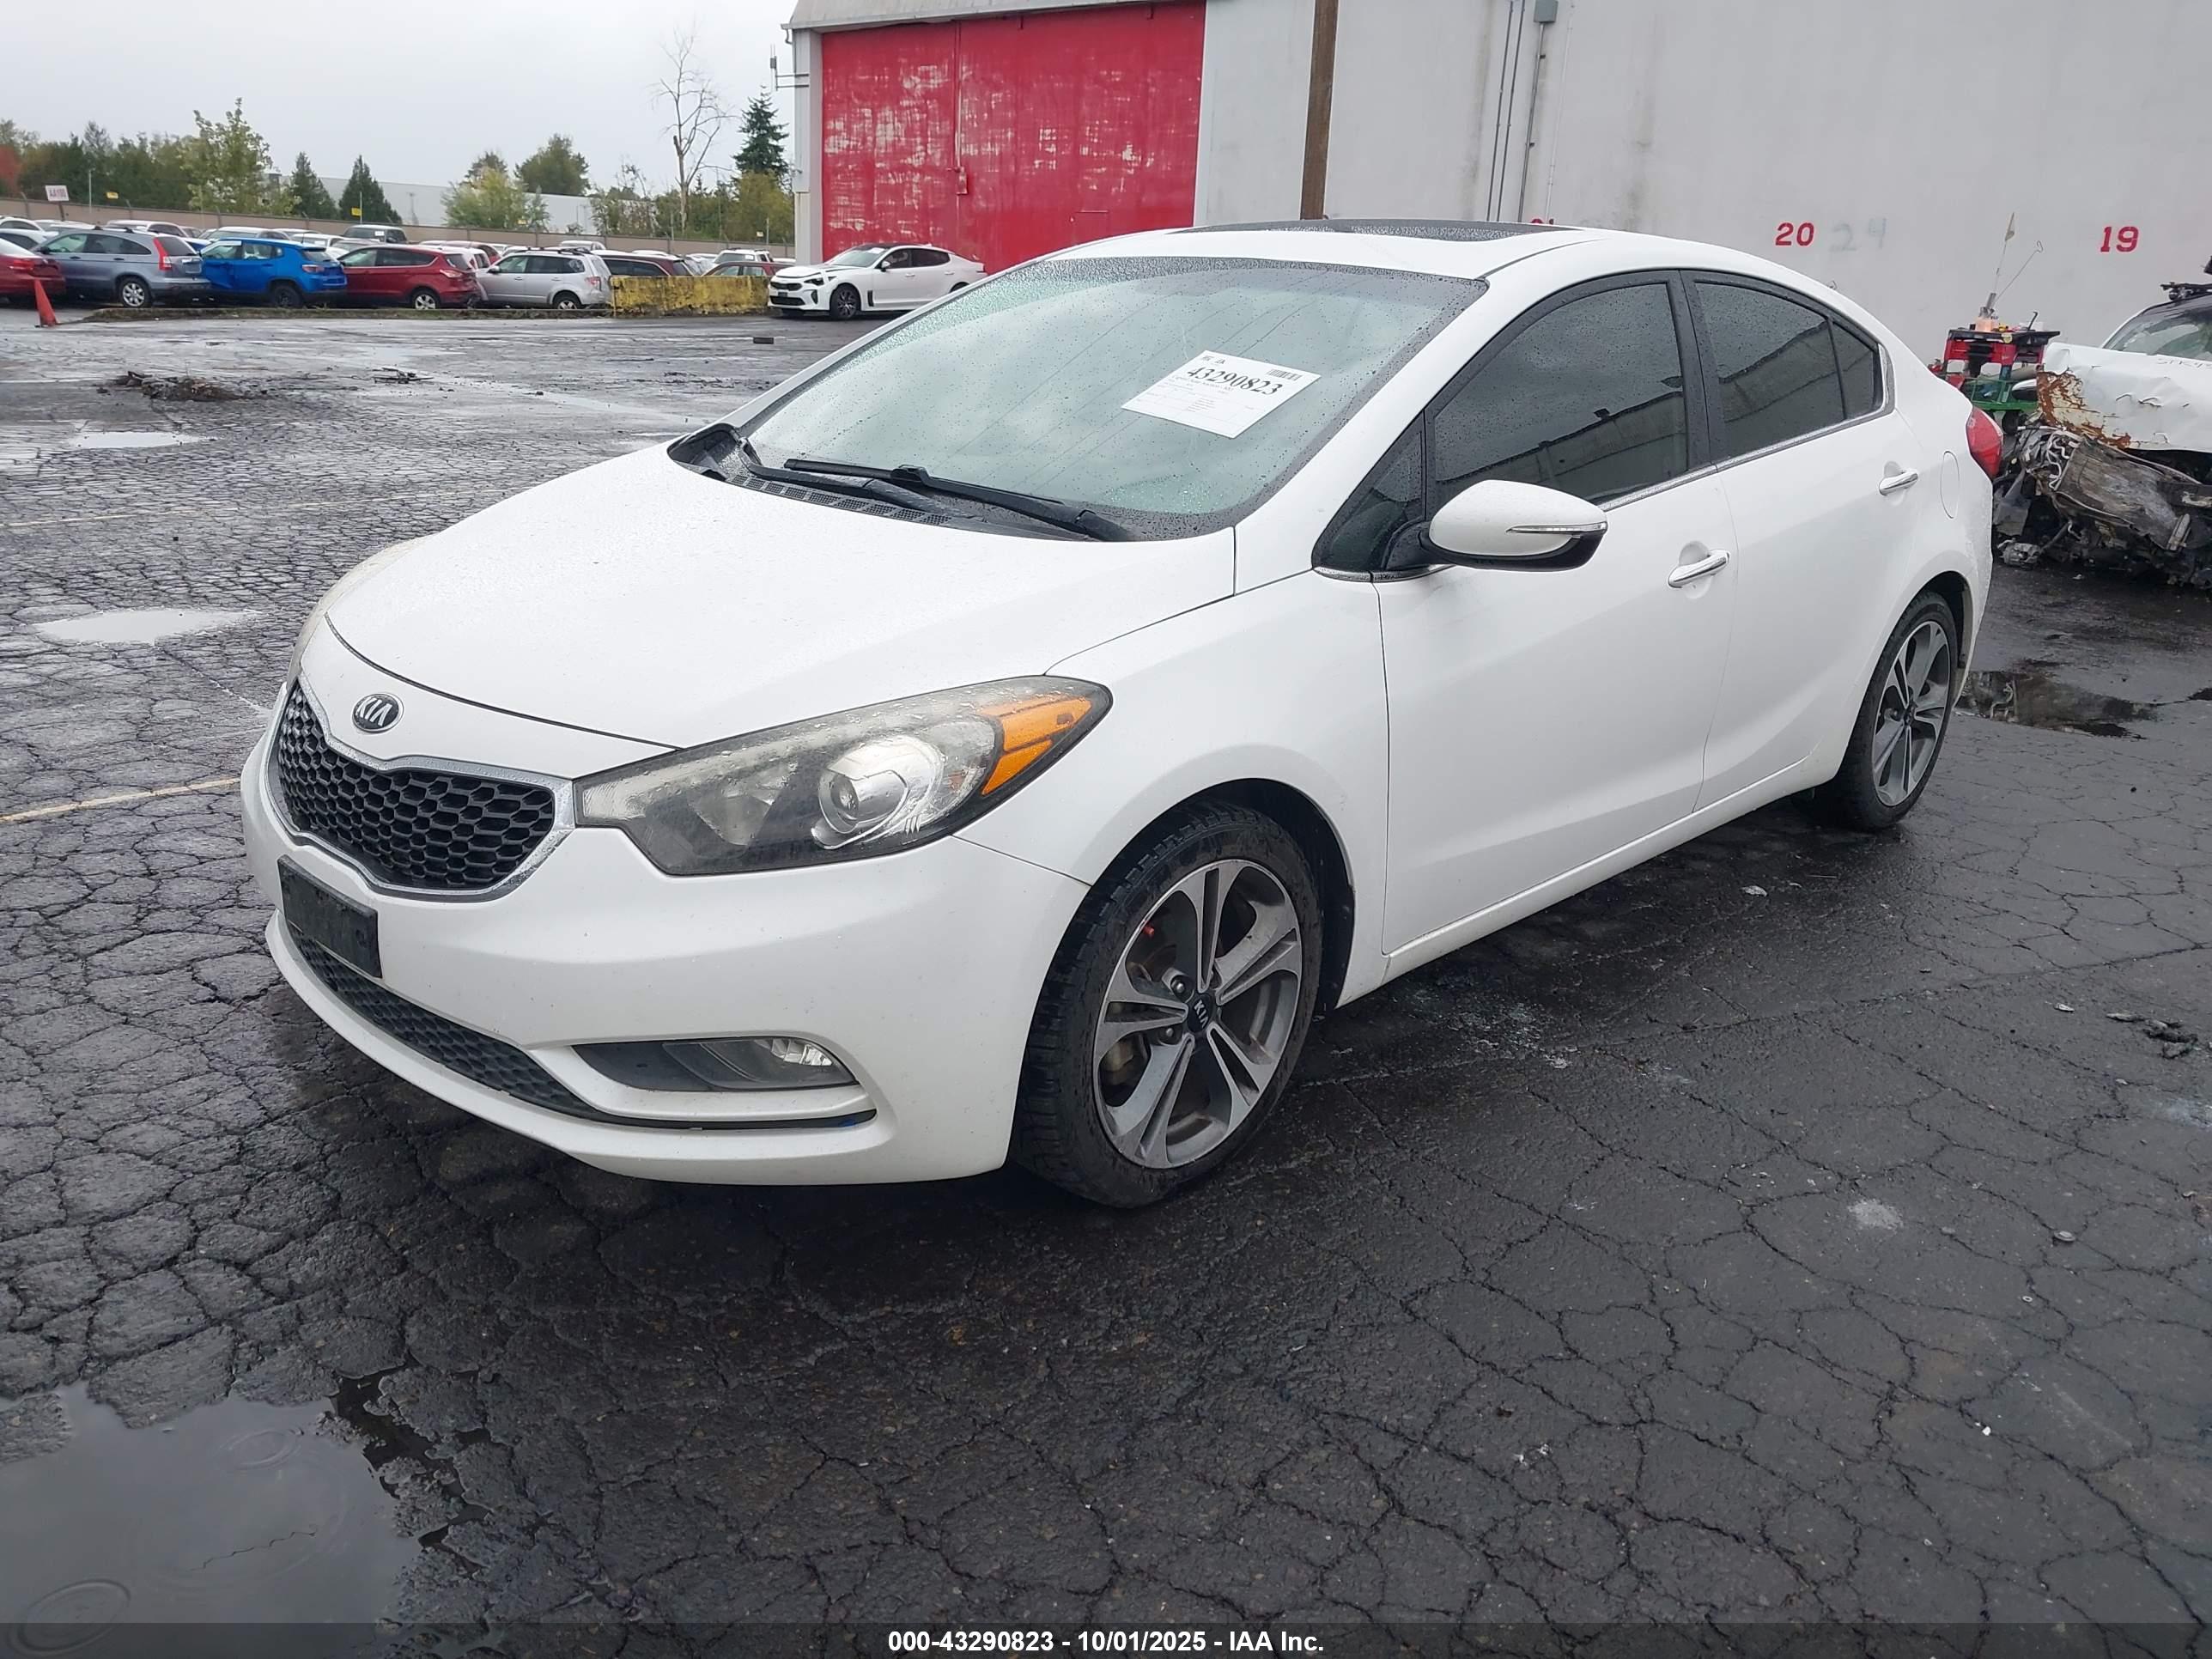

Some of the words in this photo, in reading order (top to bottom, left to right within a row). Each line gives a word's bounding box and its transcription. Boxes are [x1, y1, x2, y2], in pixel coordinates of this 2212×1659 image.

[1775, 222, 1814, 246] 20
[2100, 226, 2139, 252] 19
[1187, 367, 1284, 395] 43290823
[356, 696, 393, 726] KIA
[1194, 999, 1209, 1029] KIA
